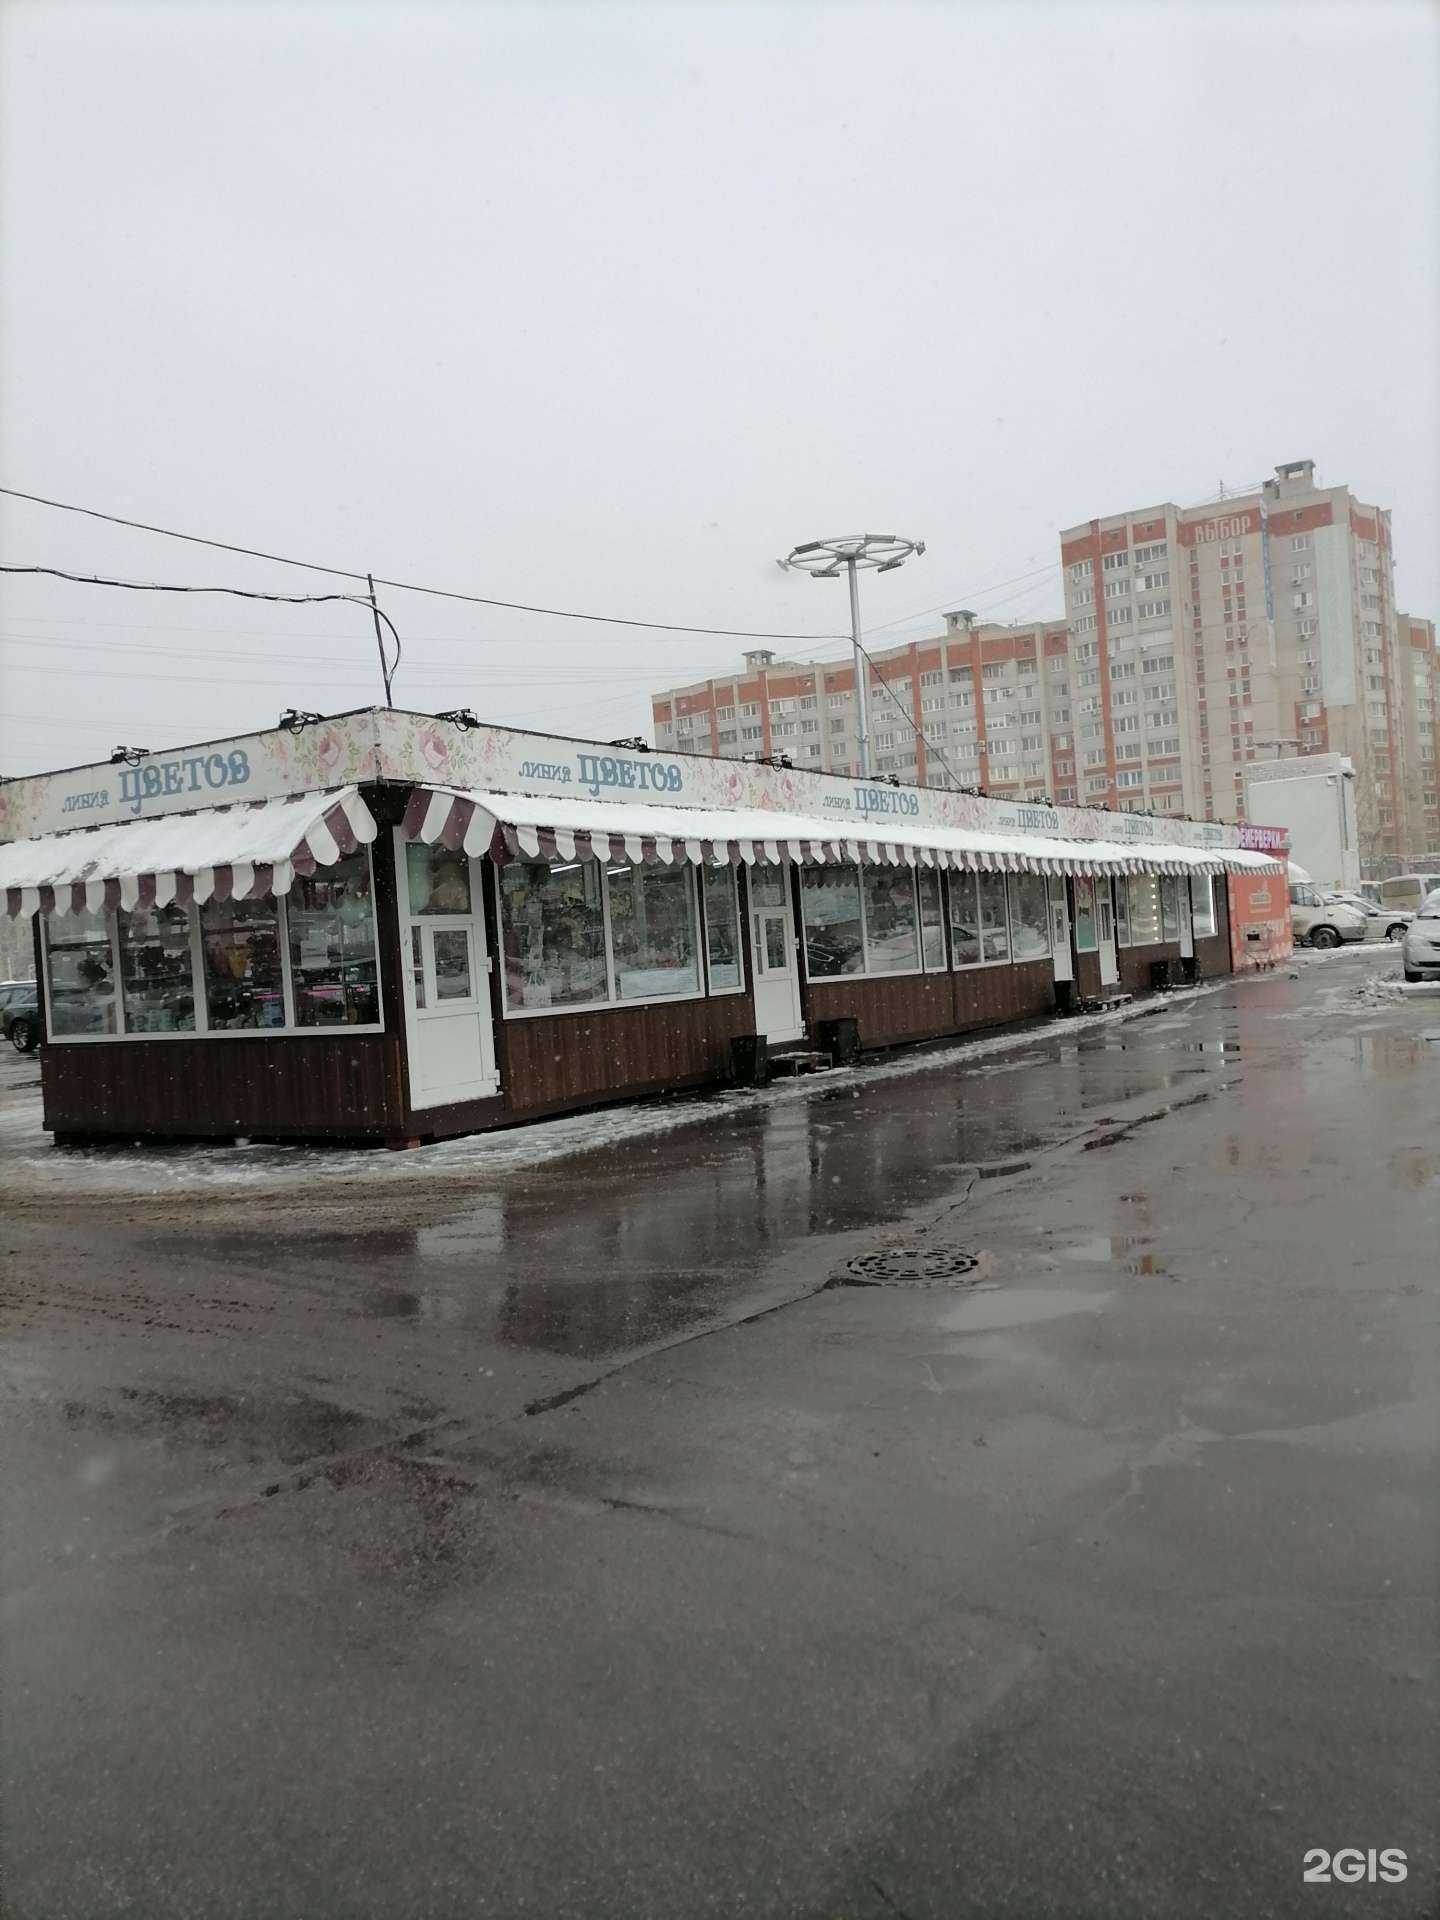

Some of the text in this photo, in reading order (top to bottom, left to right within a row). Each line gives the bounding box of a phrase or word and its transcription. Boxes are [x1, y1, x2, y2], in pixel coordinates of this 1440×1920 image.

[118, 750, 250, 815] ЦВЕТОВ
[577, 753, 683, 796] ЦВЕТОВ
[853, 787, 919, 821] ЦВЕТОВ
[1016, 808, 1059, 833] ЦВЕТОВ
